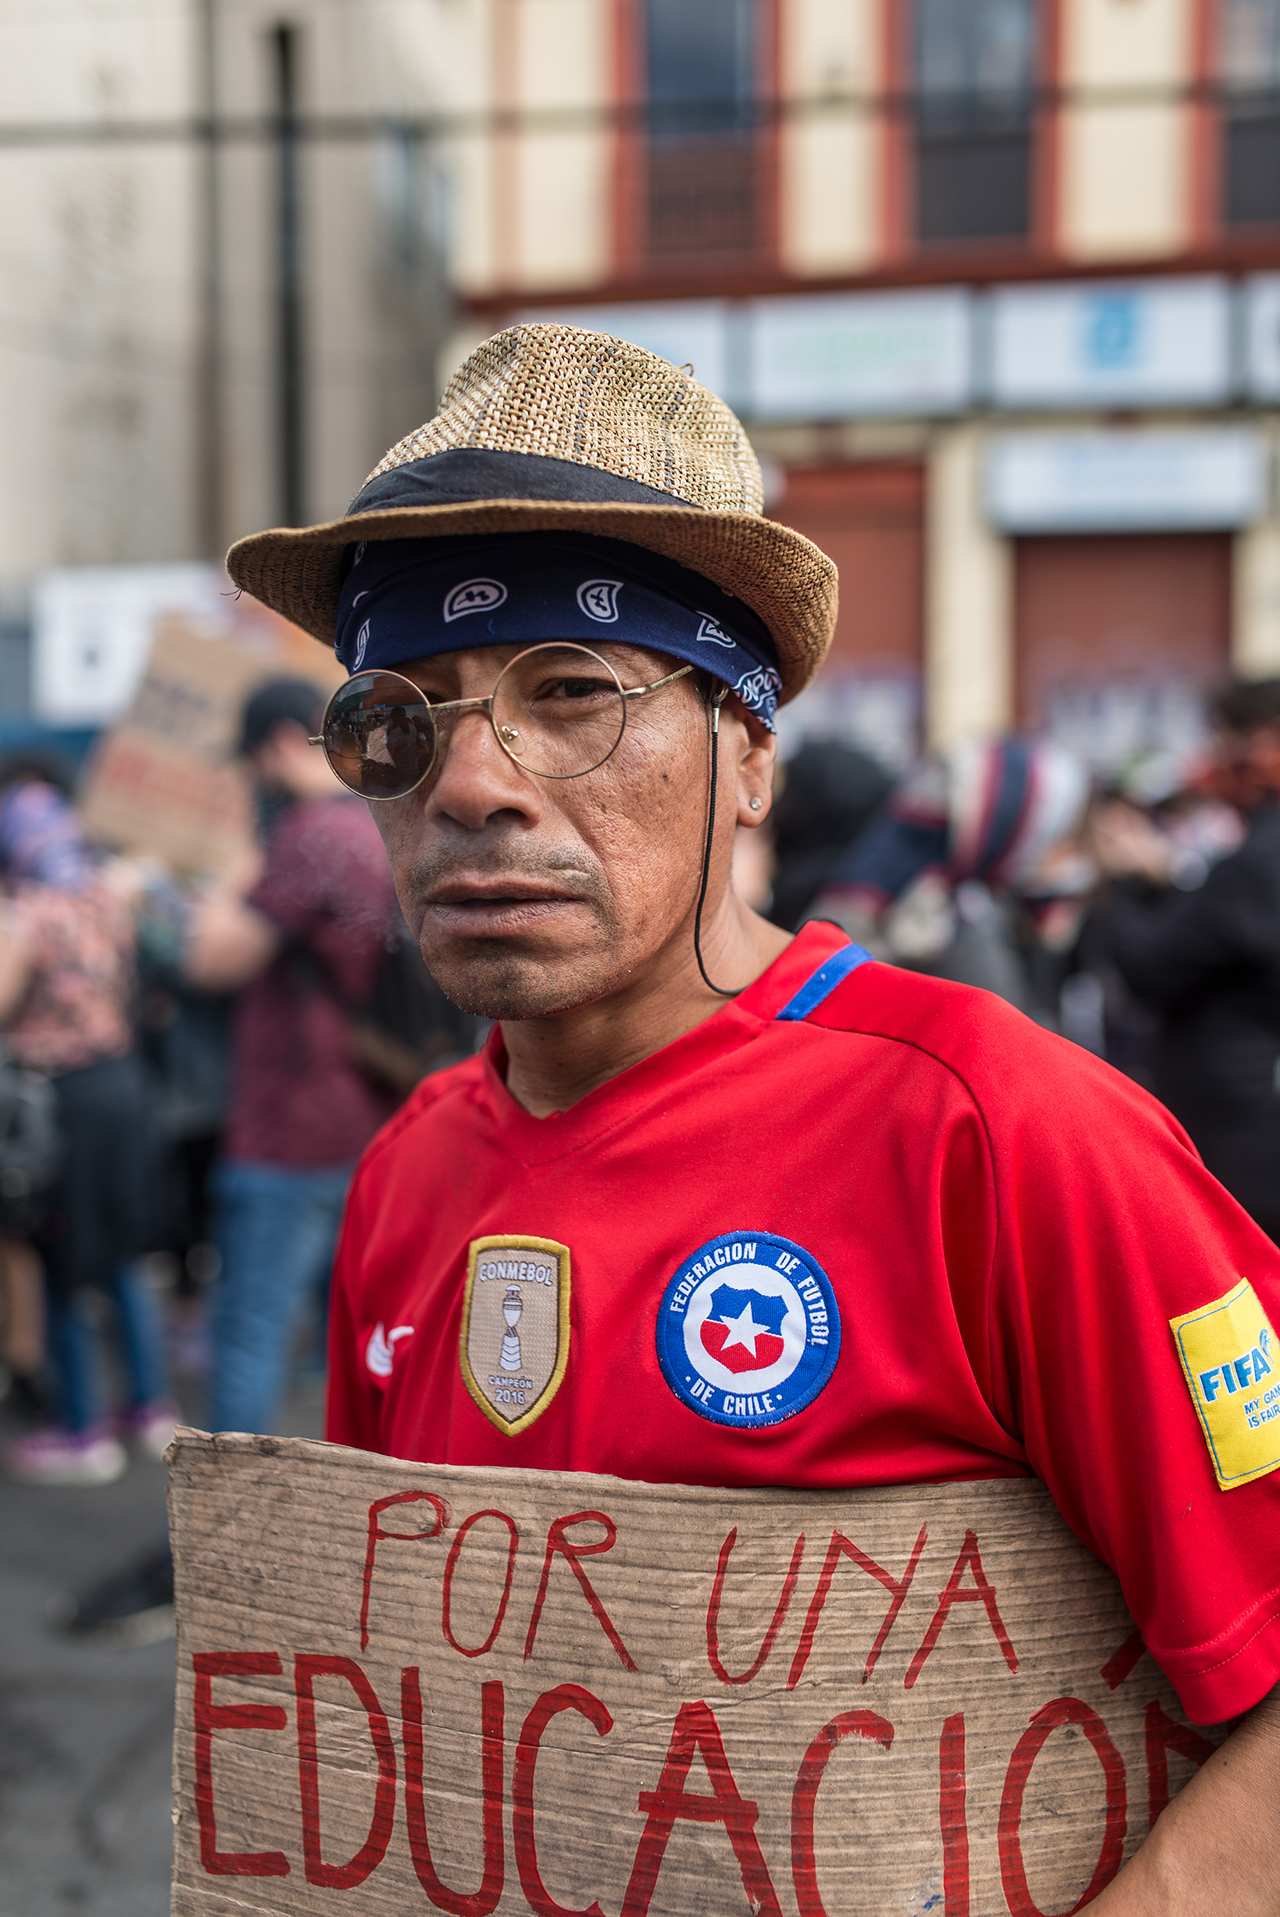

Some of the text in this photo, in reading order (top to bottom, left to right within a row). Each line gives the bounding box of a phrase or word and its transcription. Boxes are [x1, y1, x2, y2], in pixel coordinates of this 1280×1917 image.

[478, 1261, 553, 1286] CONMEBOL
[669, 1242, 830, 1346] FEDERACION DE FUTBOL
[487, 1374, 533, 1390] CAMPEÓN
[1198, 1346, 1272, 1403] FIFA
[494, 1389, 526, 1404] 2016
[690, 1378, 776, 1416] DE CHILE
[1243, 1397, 1260, 1415] MY
[1247, 1403, 1280, 1429] IS FAIR
[360, 1490, 1019, 1691] POR UNA
